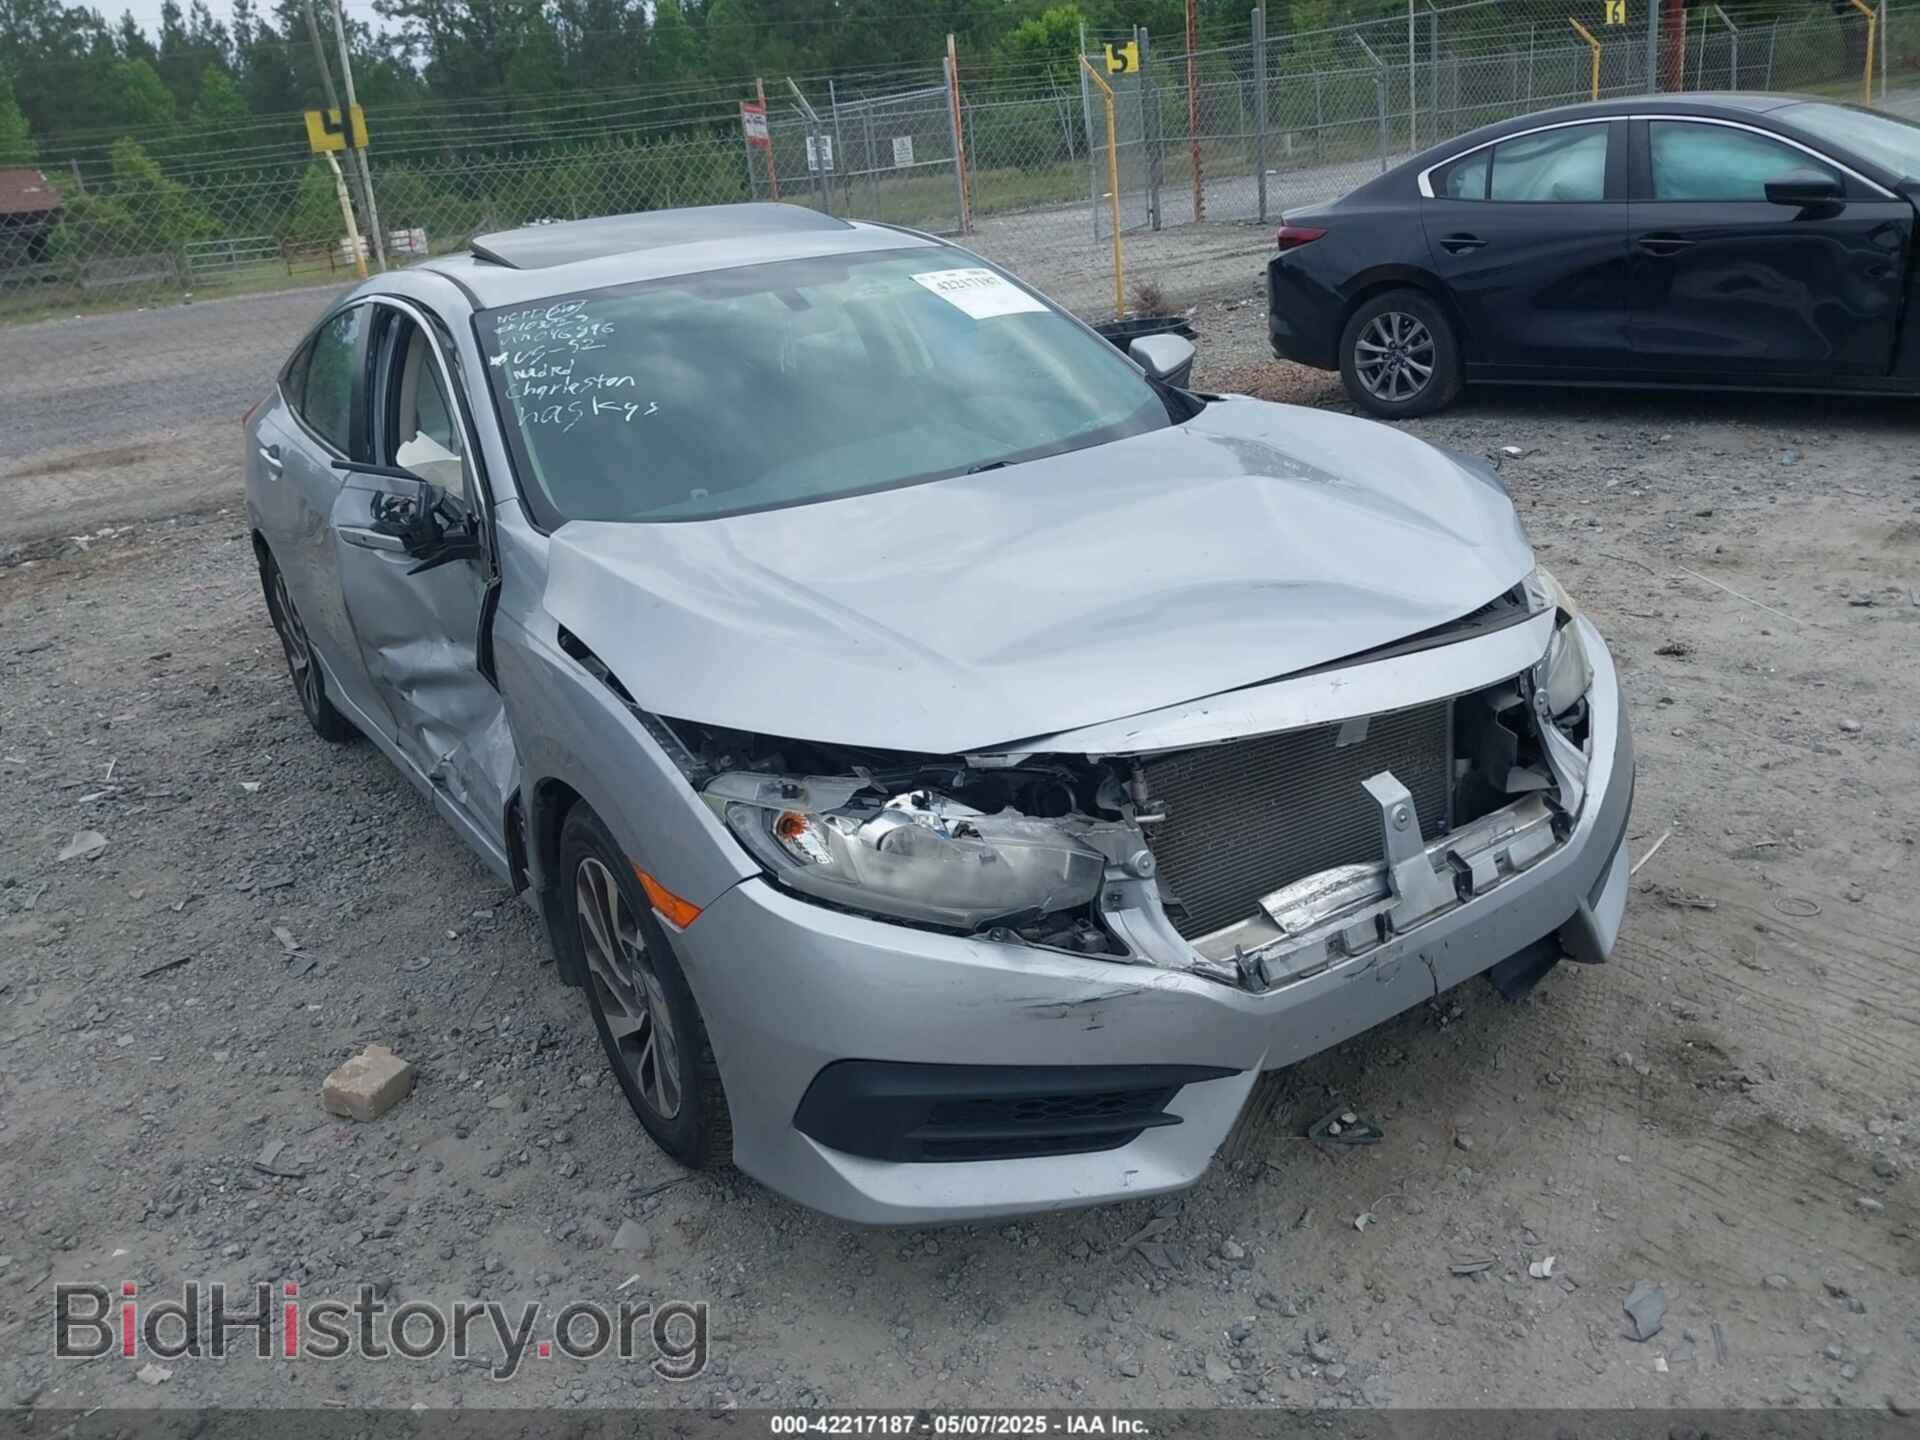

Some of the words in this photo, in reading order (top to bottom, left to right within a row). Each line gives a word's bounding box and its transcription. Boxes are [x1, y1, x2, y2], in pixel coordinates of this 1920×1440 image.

[1612, 1, 1620, 23] 6
[1111, 41, 1128, 72] 5
[320, 105, 357, 148] 4
